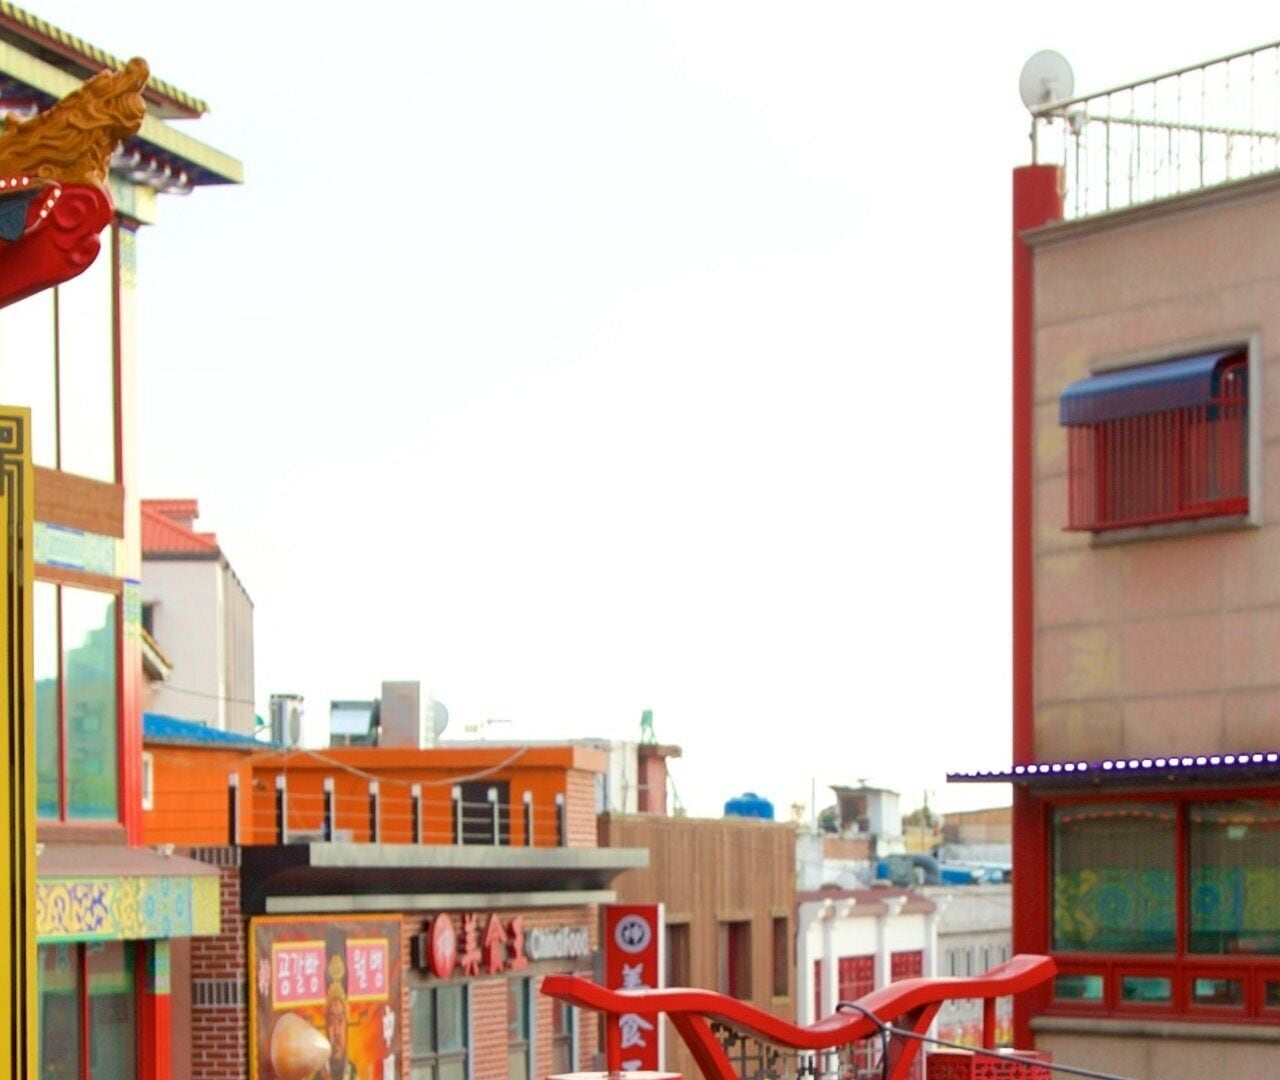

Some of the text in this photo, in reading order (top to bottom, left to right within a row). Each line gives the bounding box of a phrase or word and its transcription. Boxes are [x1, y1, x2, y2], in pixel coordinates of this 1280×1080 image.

[276, 951, 320, 996] 공갈빵
[352, 948, 386, 990] 월병
[619, 962, 656, 1072] 美食
